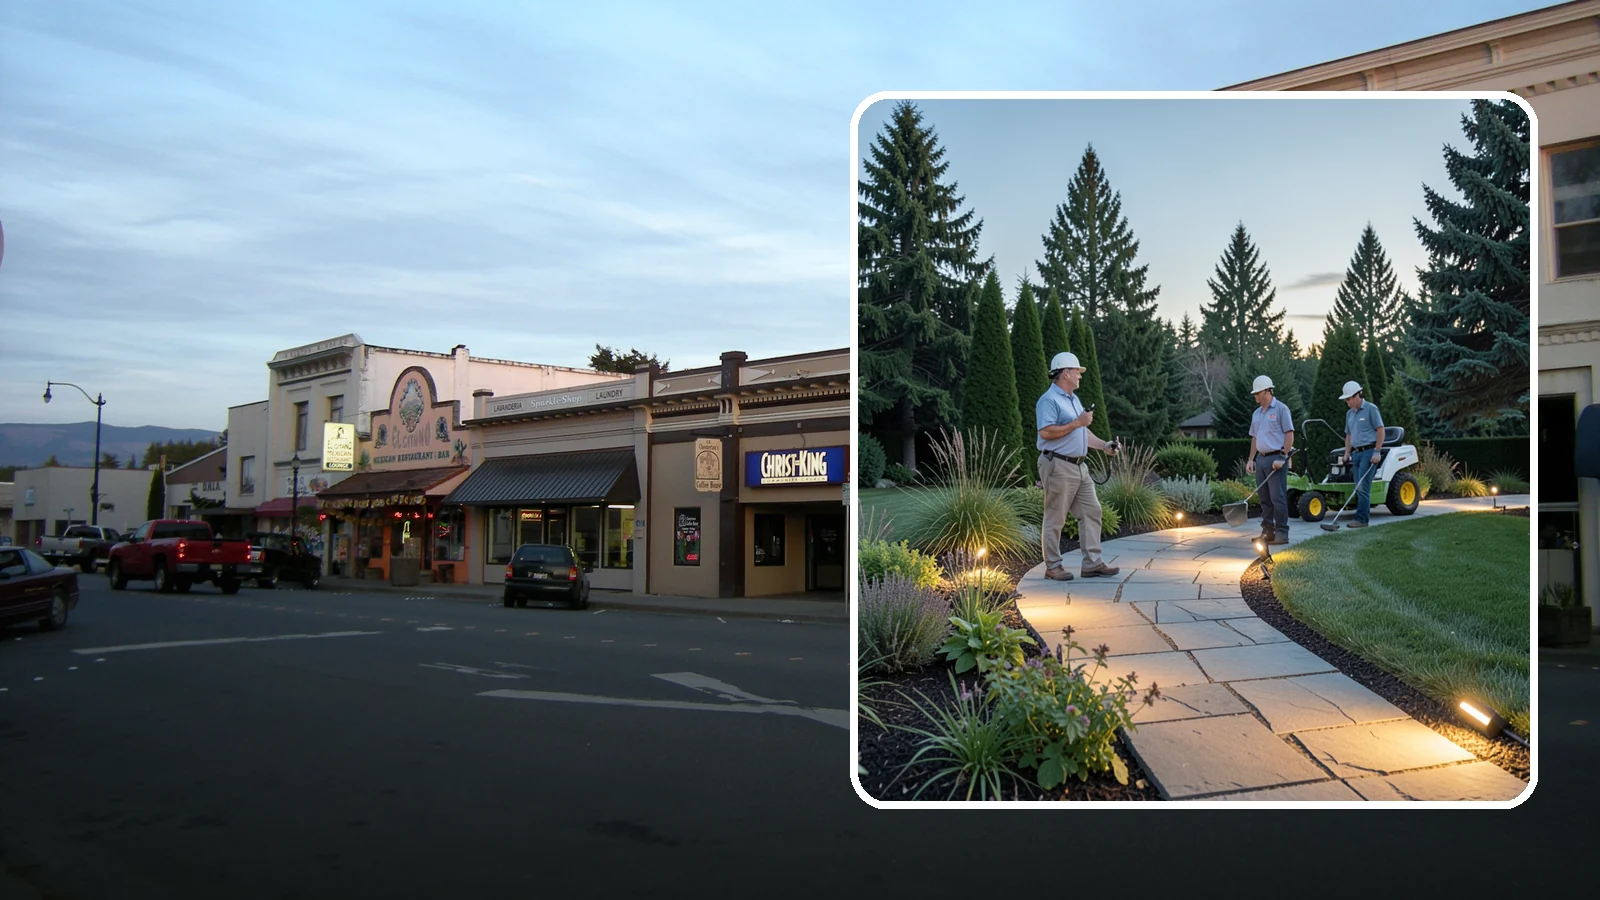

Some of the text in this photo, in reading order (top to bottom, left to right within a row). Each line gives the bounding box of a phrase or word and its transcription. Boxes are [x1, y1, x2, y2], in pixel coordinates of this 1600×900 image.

[595, 389, 623, 400] LAUNDRY
[493, 402, 522, 413] LAVANDERIA
[373, 454, 396, 464] MEXICAN
[397, 451, 433, 463] RESTAURANT
[437, 450, 450, 459] BAR
[760, 450, 827, 478] CHRIST KING
